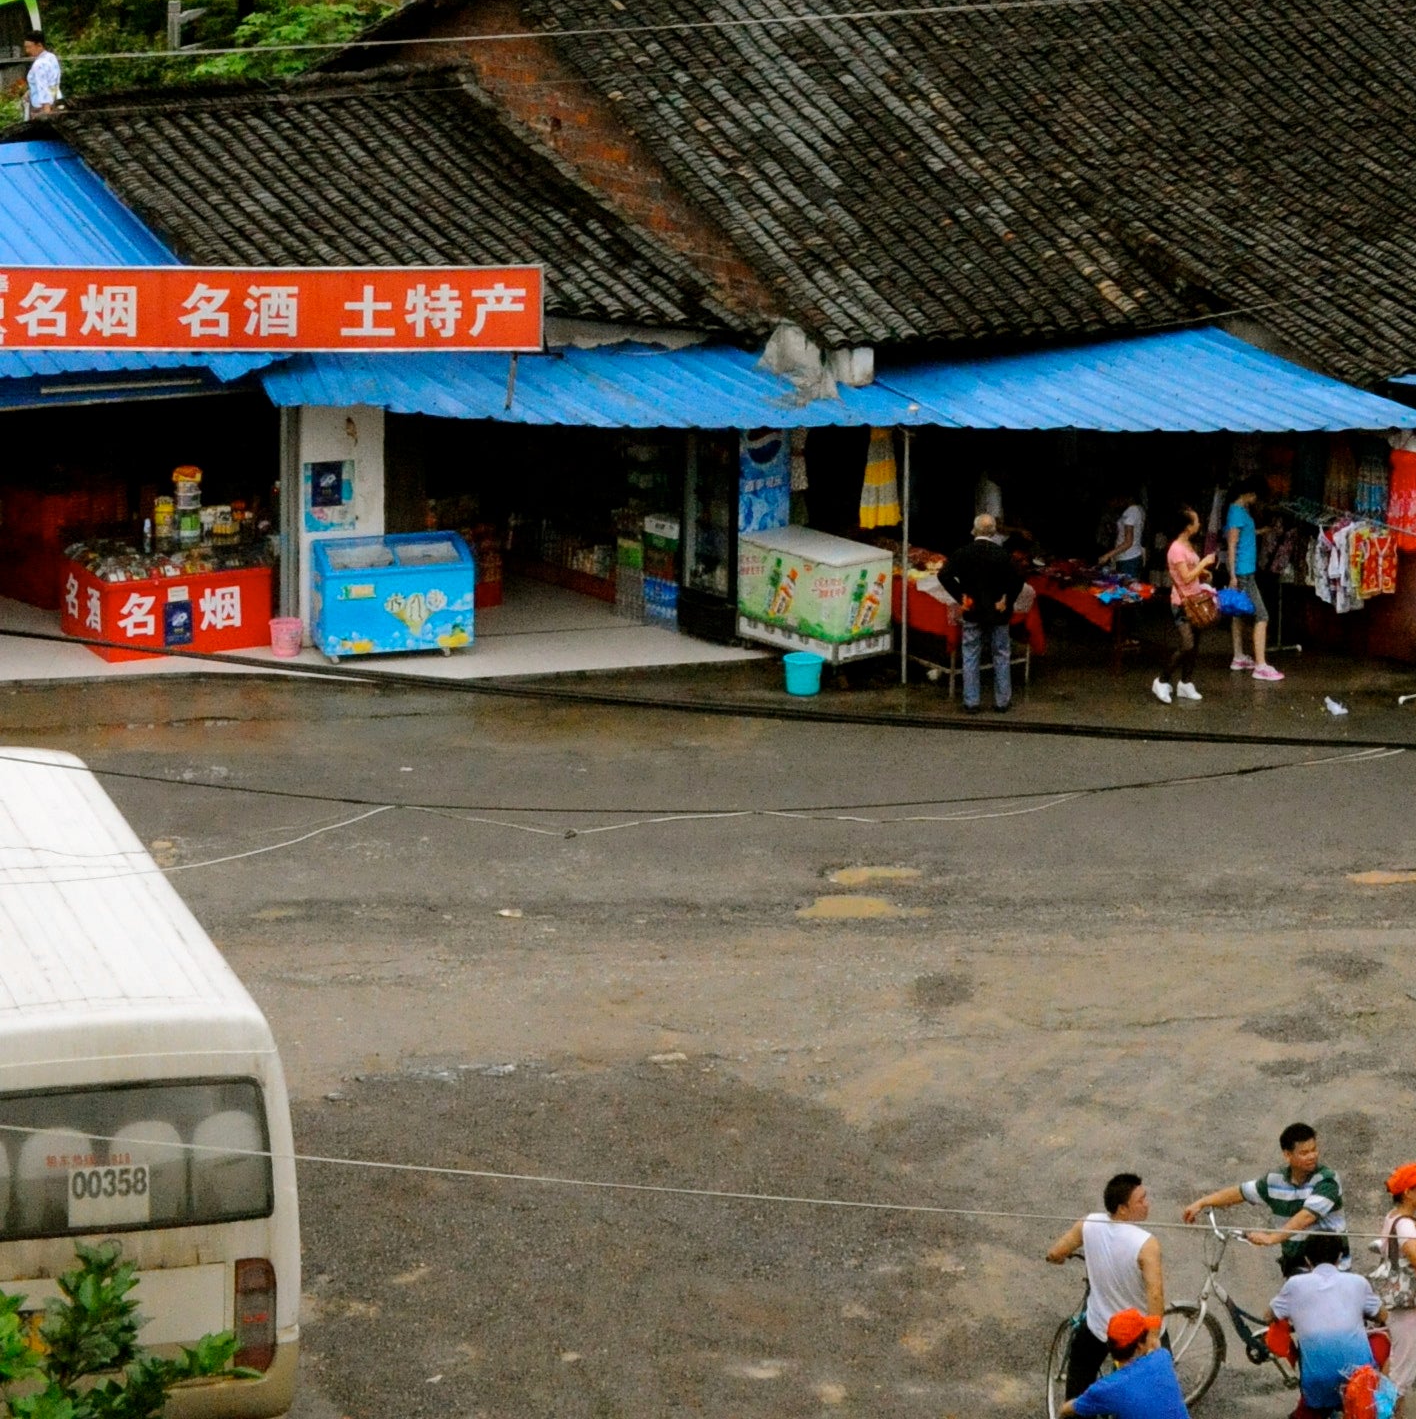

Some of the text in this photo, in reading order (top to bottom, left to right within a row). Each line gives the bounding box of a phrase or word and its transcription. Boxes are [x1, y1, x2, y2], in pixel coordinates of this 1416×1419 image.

[15, 282, 138, 337] 名烟
[178, 282, 299, 337] 名酒
[340, 282, 527, 338] 土特产
[65, 572, 102, 634] 名酒
[117, 585, 242, 638] 名烟
[71, 1166, 147, 1200] 00358
